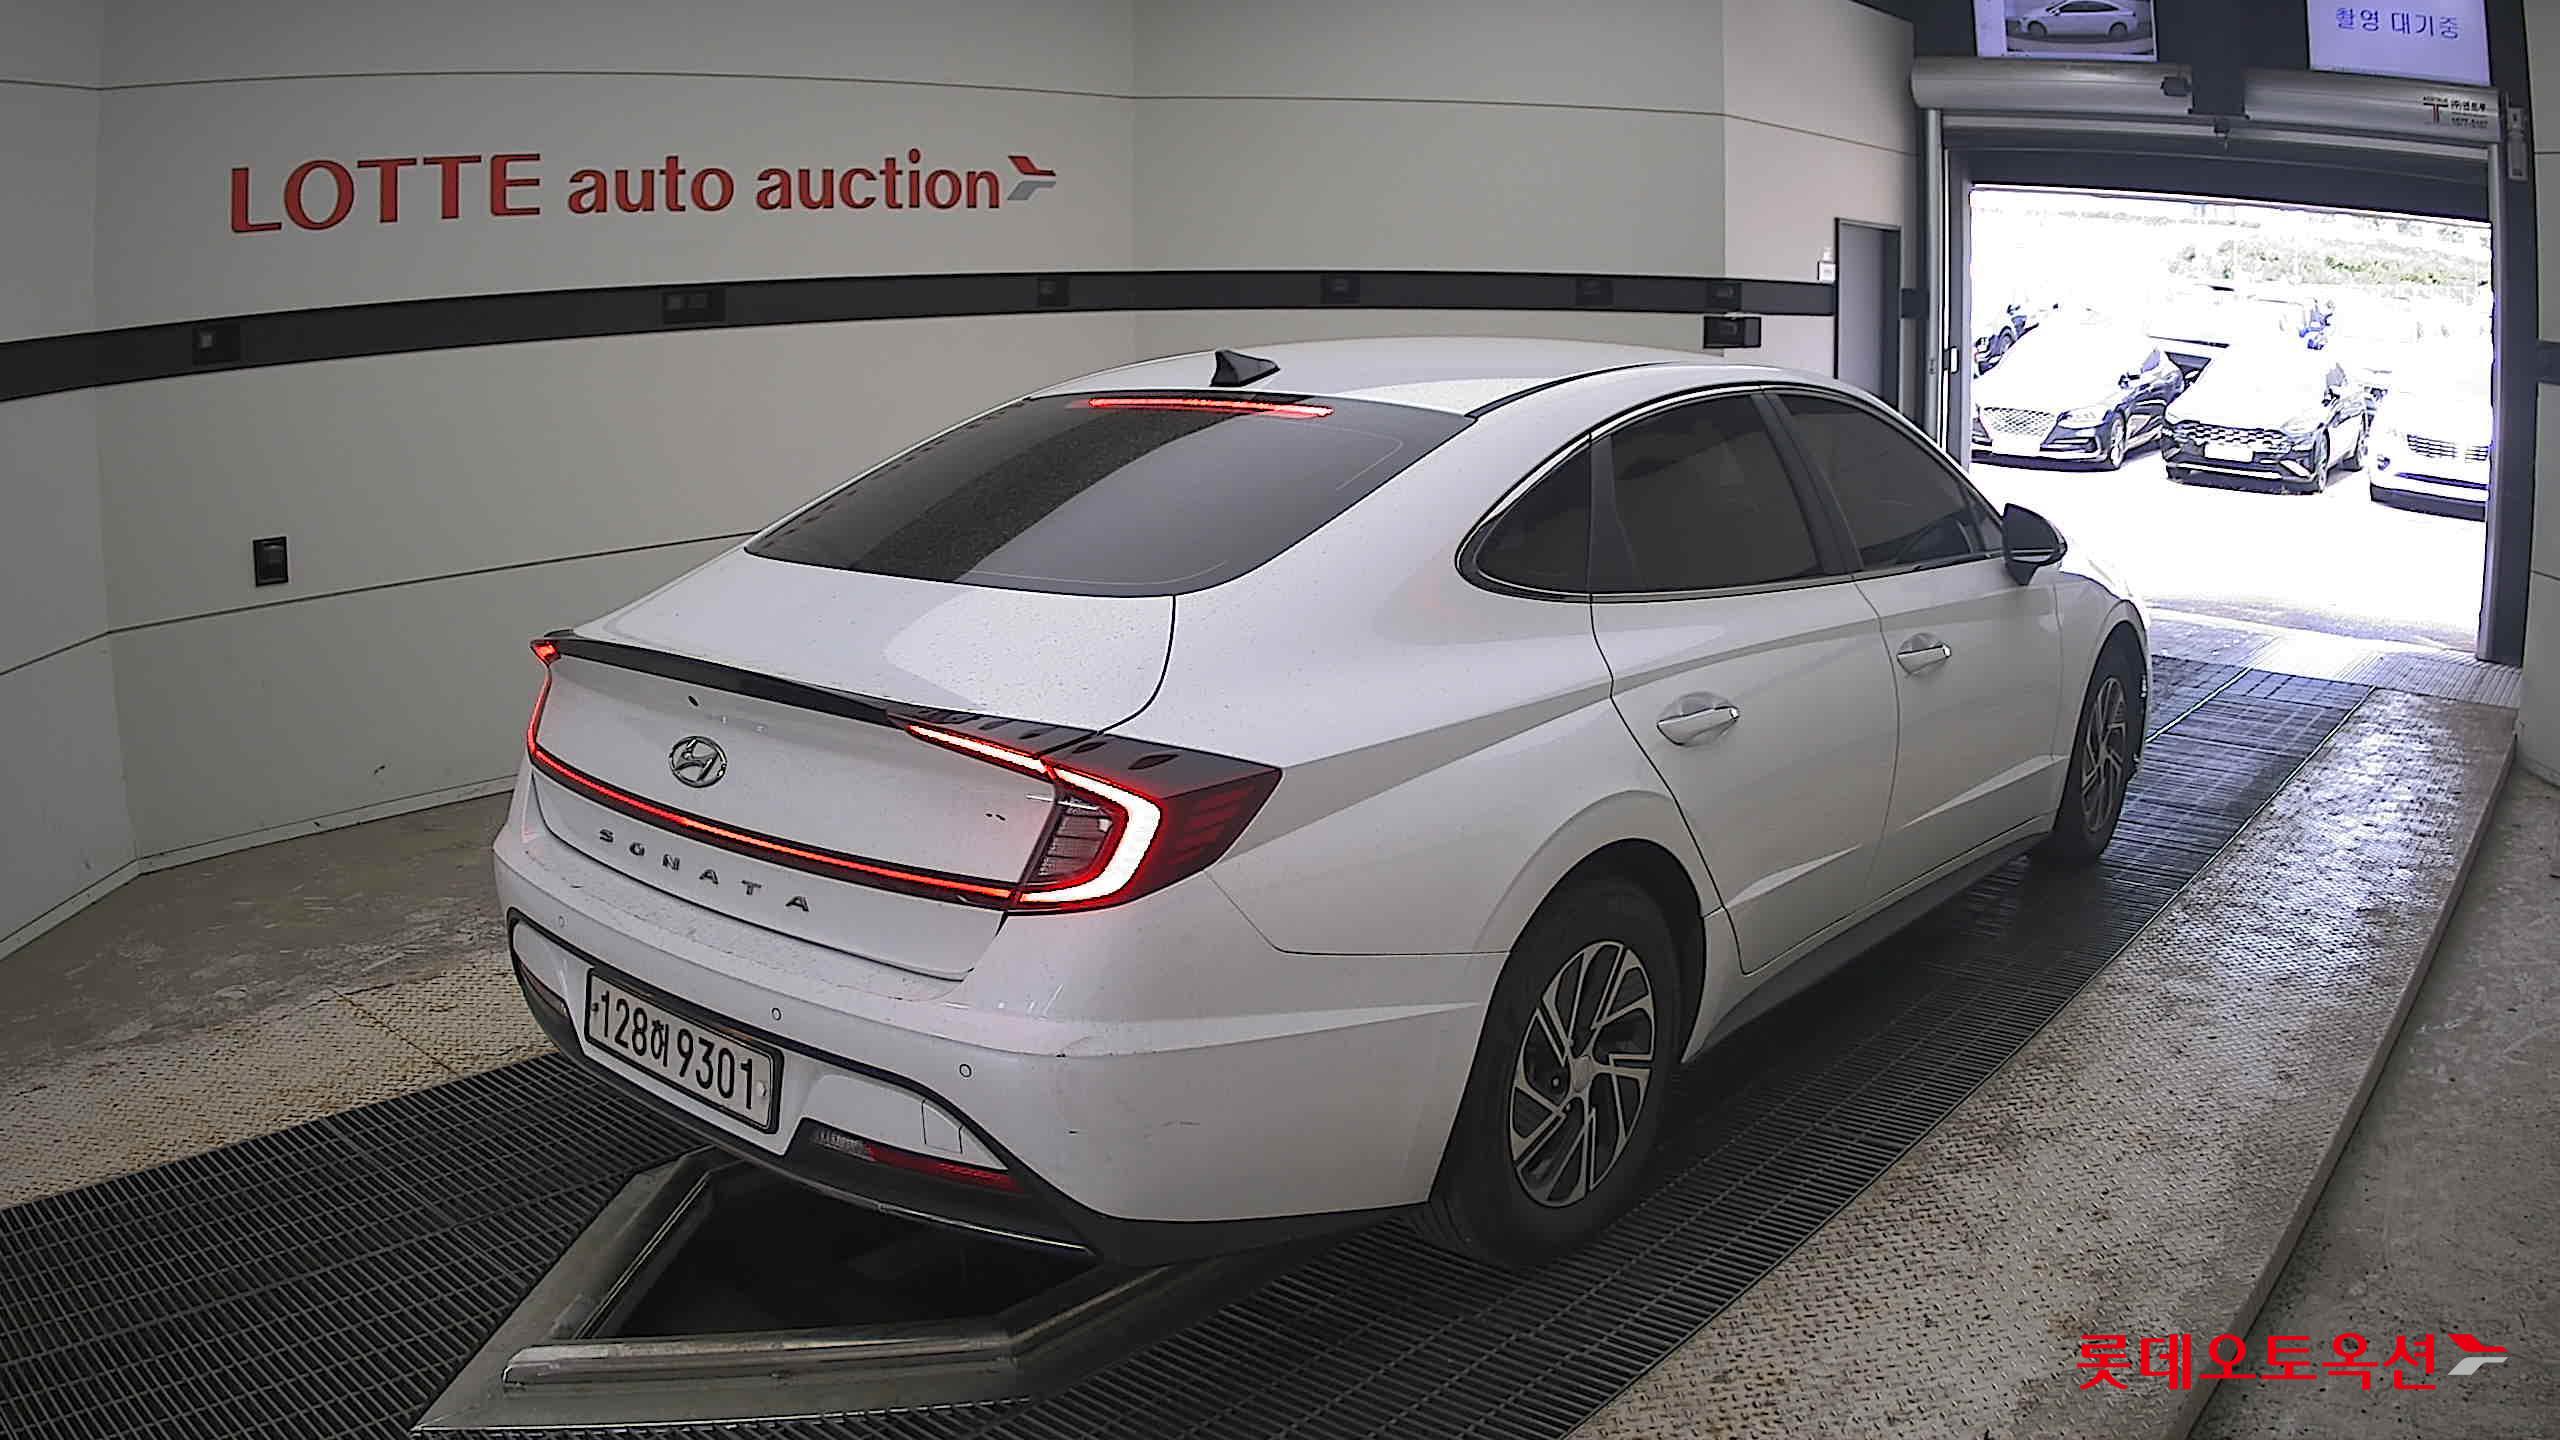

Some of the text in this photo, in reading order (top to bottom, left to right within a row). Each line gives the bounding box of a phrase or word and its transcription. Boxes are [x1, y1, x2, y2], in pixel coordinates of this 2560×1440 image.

[2336, 7, 2459, 39] 촬영 대기중
[231, 148, 1001, 233] LOTTE auto auction
[599, 828, 810, 912] SONATA
